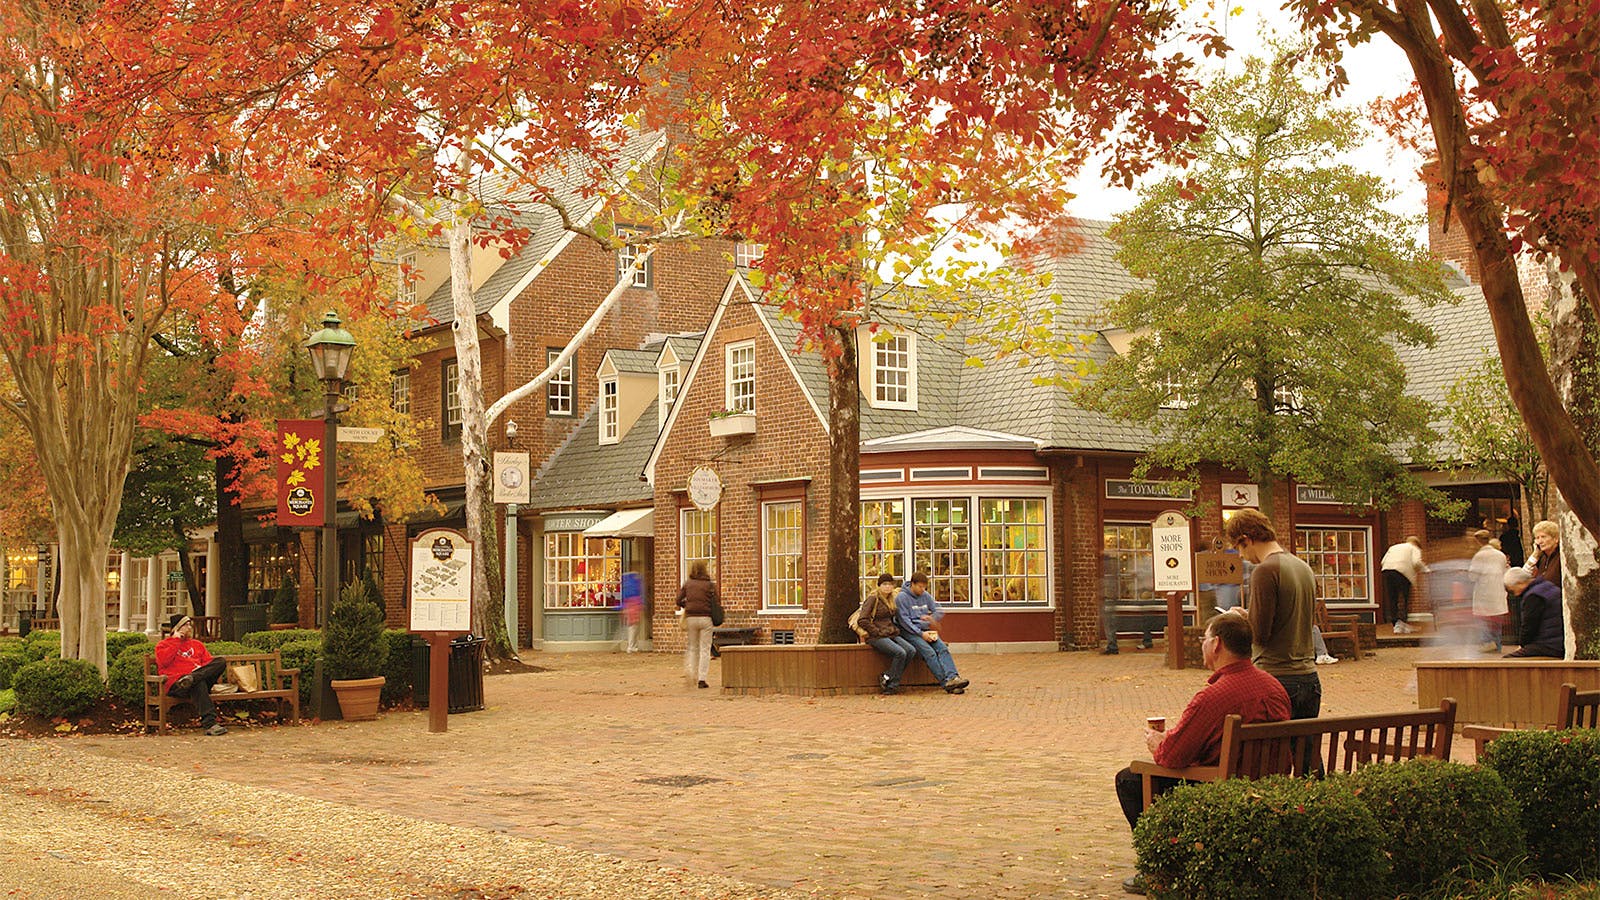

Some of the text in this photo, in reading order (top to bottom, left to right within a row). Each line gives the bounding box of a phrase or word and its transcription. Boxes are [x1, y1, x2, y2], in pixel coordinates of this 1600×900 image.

[1128, 483, 1171, 495] TOYMAKE
[1160, 534, 1183, 543] MORE
[1160, 543, 1183, 552] SHOPS
[1206, 560, 1226, 569] MORE
[1205, 568, 1228, 577] SHOPS
